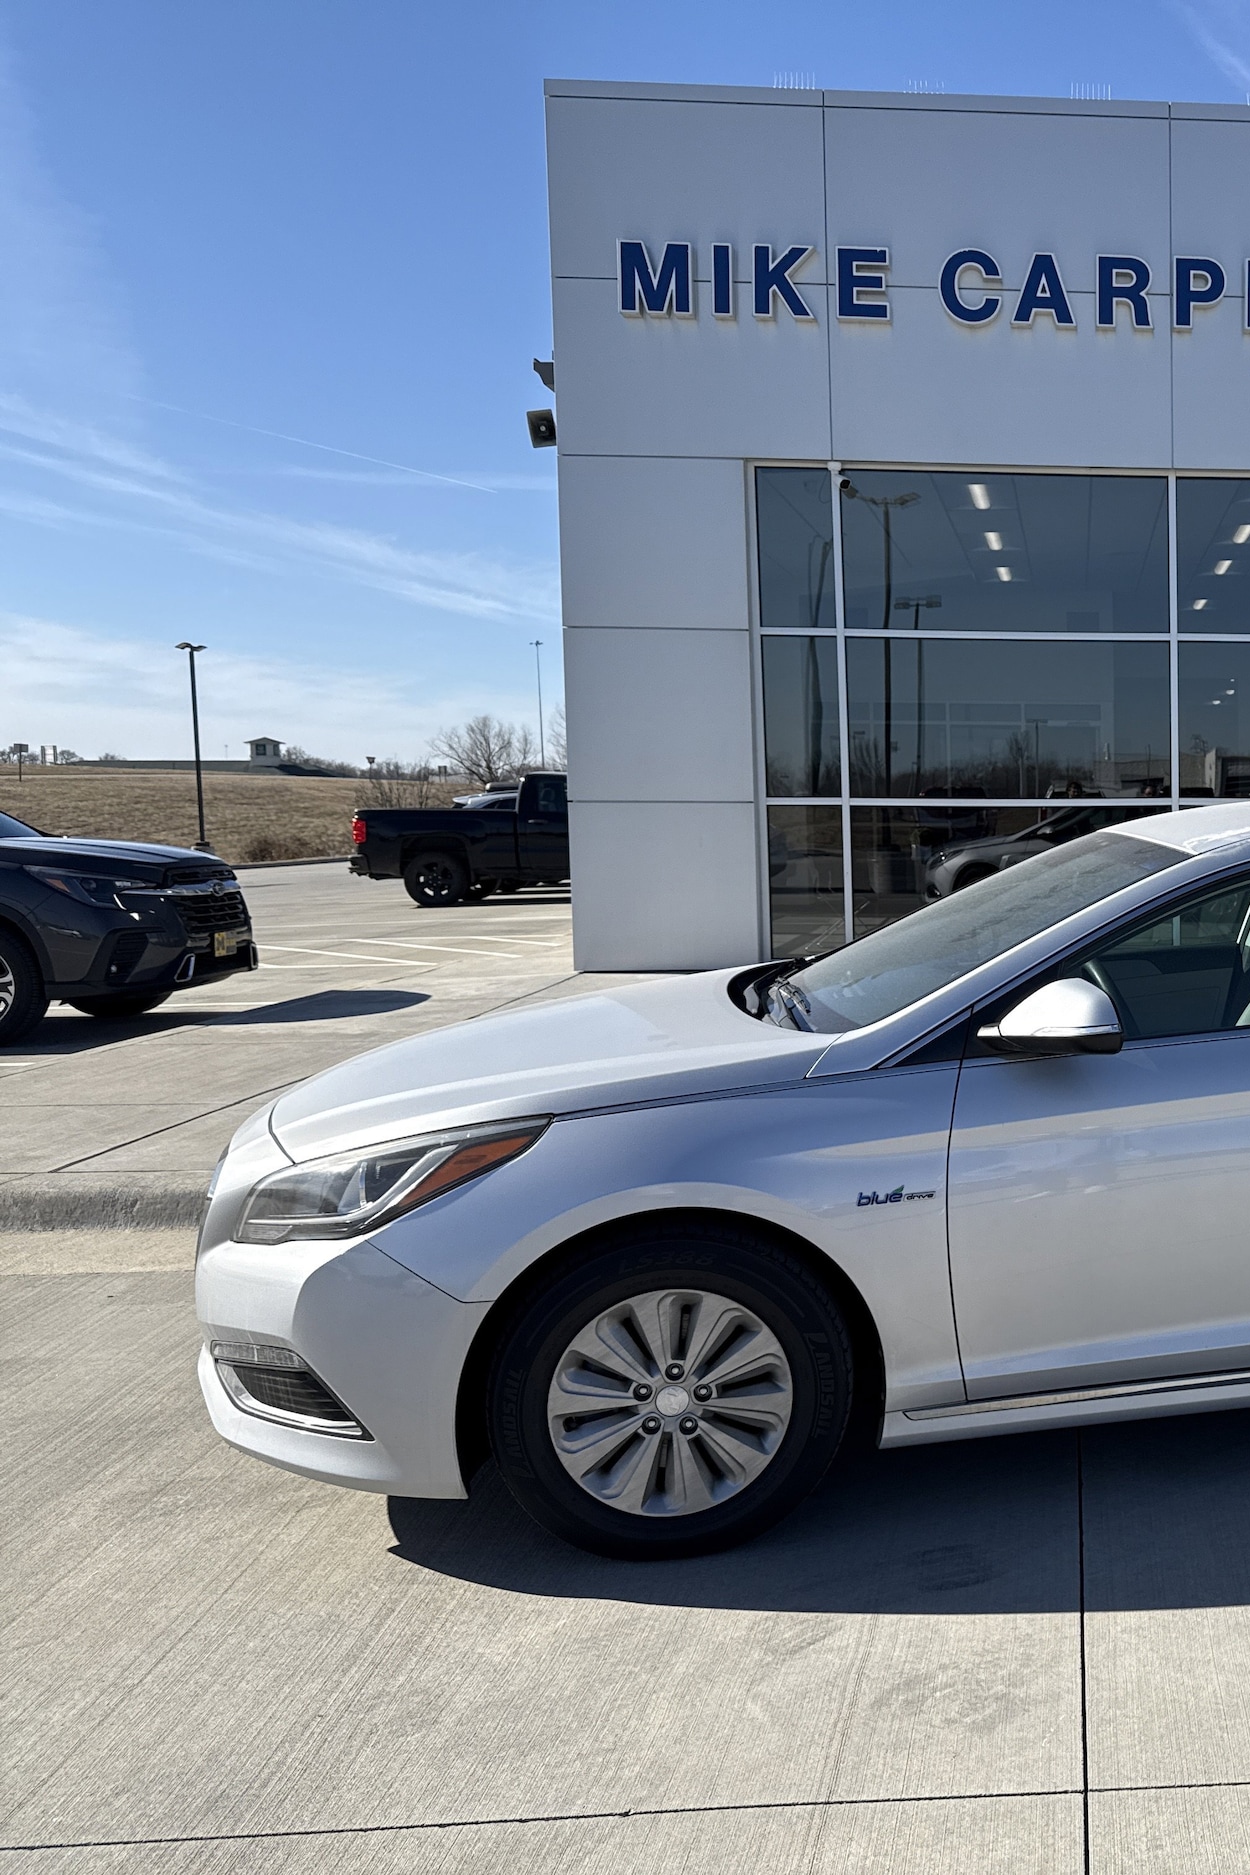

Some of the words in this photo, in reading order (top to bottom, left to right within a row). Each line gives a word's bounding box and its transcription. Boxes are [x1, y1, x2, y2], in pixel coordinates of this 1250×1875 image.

[618, 239, 891, 320] MIKE
[857, 1190, 903, 1207] blue
[503, 1369, 535, 1478] LANDSAIL
[803, 1332, 836, 1438] LANDSAIL
